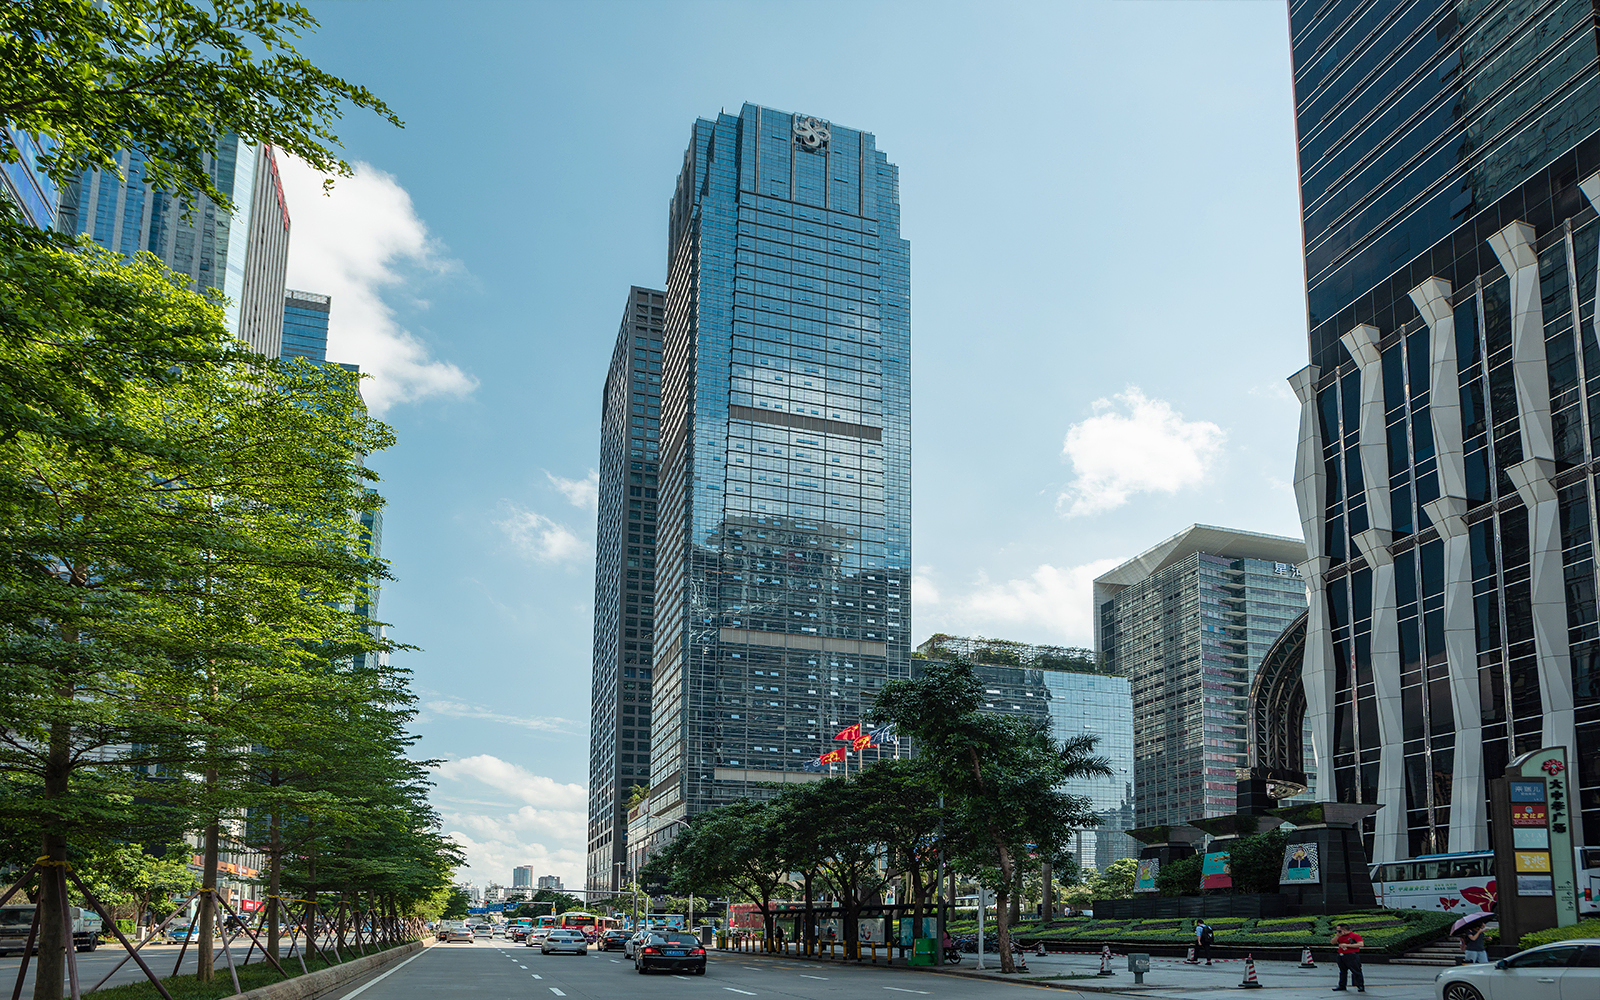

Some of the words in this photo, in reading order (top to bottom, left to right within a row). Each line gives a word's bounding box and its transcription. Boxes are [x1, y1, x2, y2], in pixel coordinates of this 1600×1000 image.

[1549, 779, 1567, 833] 大中华广场
